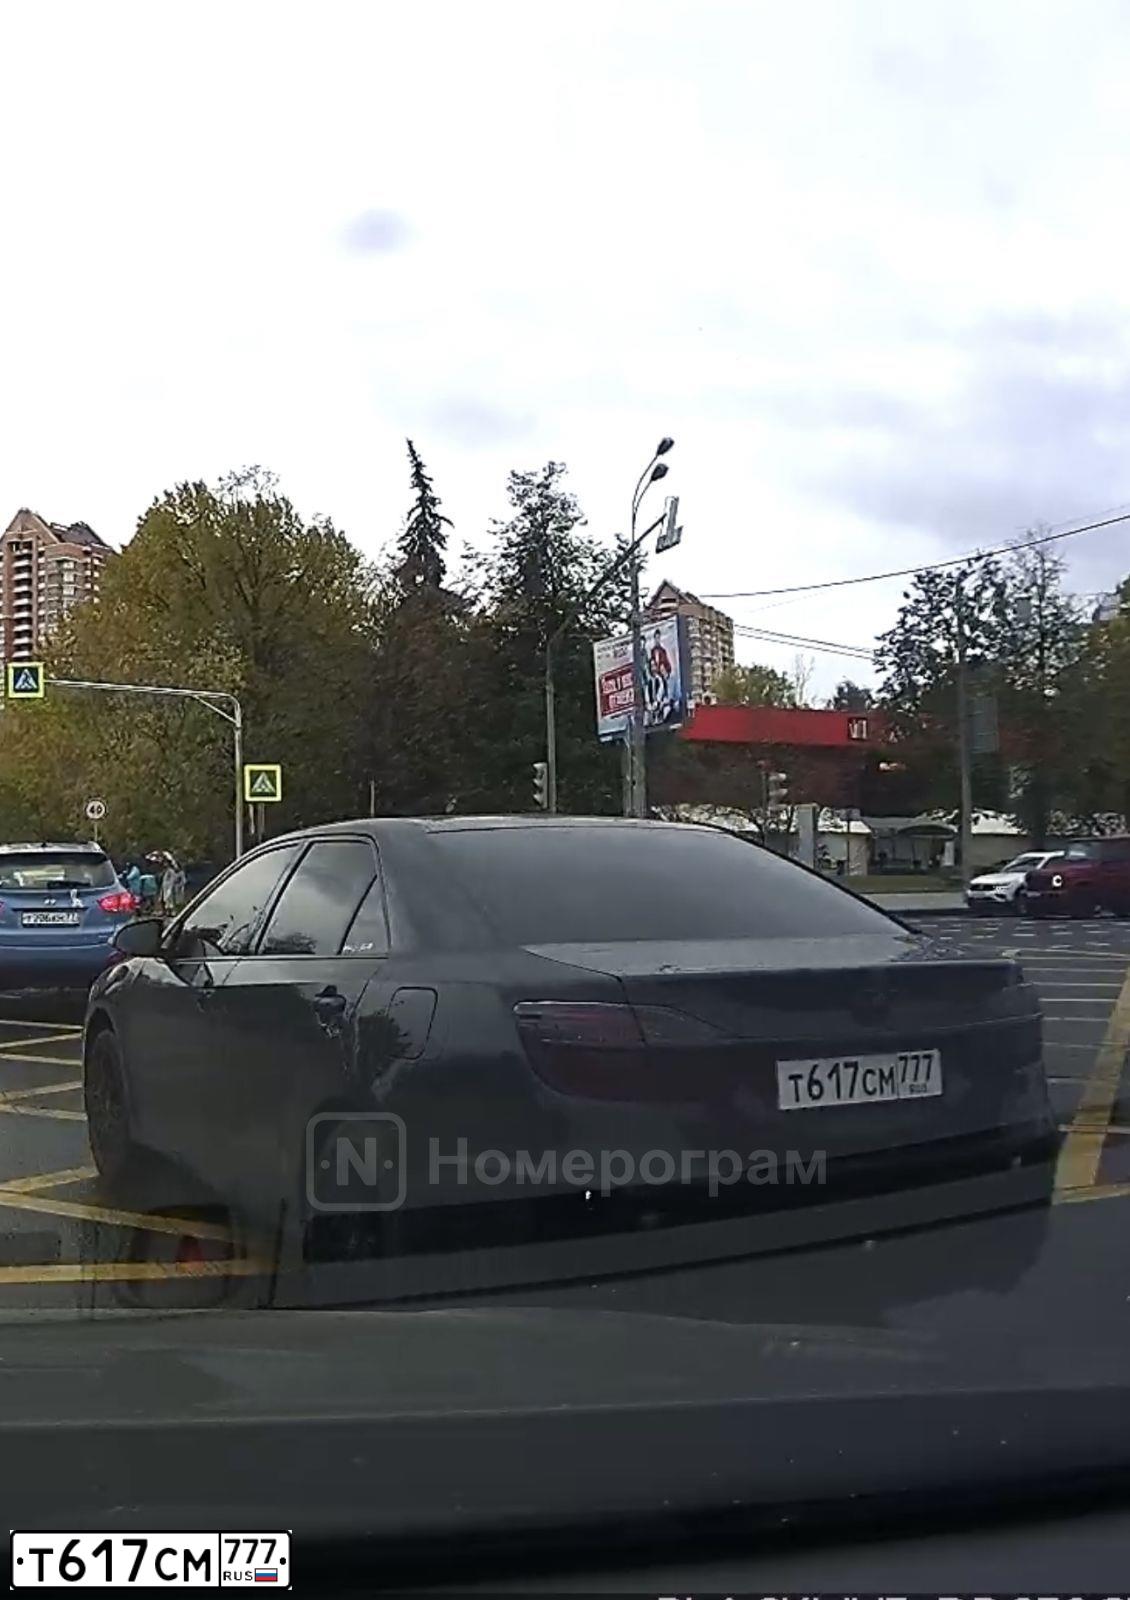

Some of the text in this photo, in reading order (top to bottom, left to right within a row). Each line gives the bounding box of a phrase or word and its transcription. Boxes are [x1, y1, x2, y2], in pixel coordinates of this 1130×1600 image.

[89, 804, 103, 813] 40
[788, 1054, 934, 1103] Т617СМ 777
